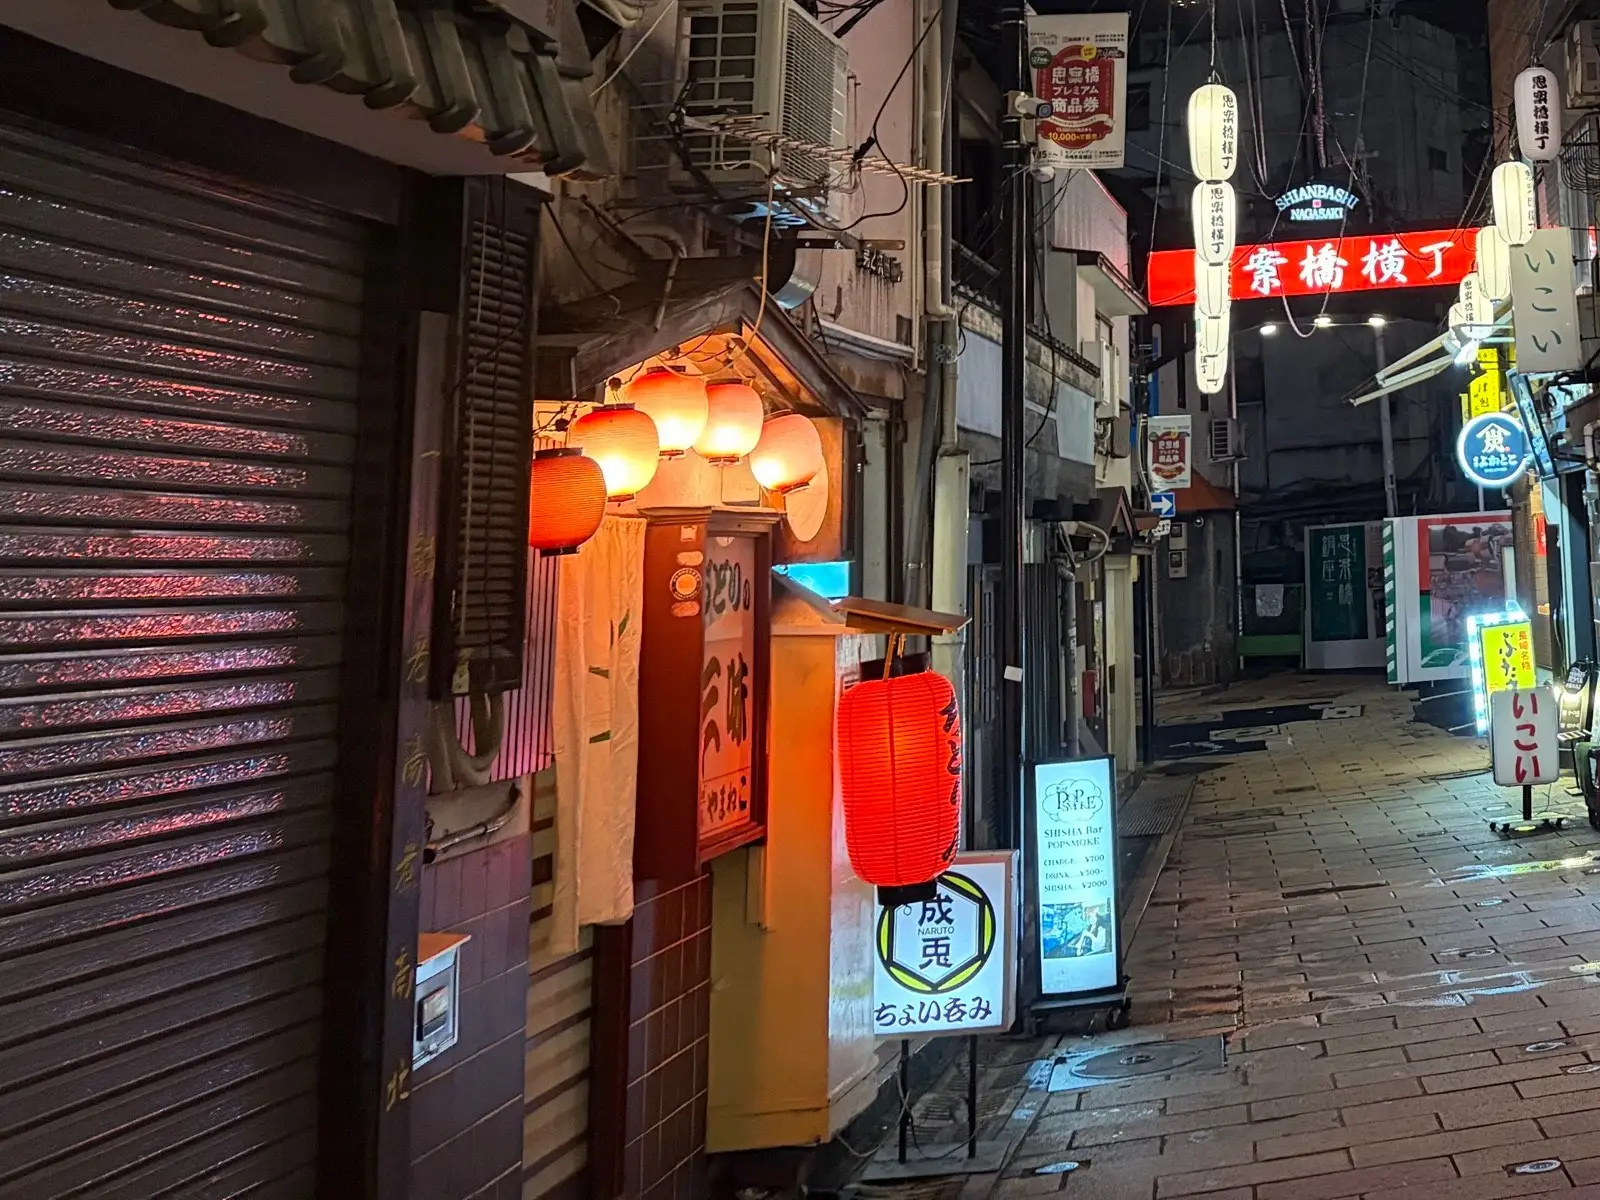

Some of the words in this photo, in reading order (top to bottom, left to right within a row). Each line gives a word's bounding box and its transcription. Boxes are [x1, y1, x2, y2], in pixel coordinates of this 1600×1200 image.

[1053, 85, 1099, 96] プレミアム
[1051, 97, 1100, 114] 商品券
[1532, 75, 1551, 151] 思案橋横丁
[1275, 184, 1360, 211] SHIANBASHI
[1290, 207, 1344, 221] NAGASAKI
[1525, 248, 1563, 354] いこい
[1512, 692, 1541, 784] いこい
[1044, 828, 1083, 839] SHISHA
[1086, 826, 1103, 835] Bar
[1047, 836, 1100, 850] POPSMOKE
[917, 892, 955, 927] 成
[917, 926, 955, 936] NARUTO
[873, 996, 993, 1027] ちょい呑み
